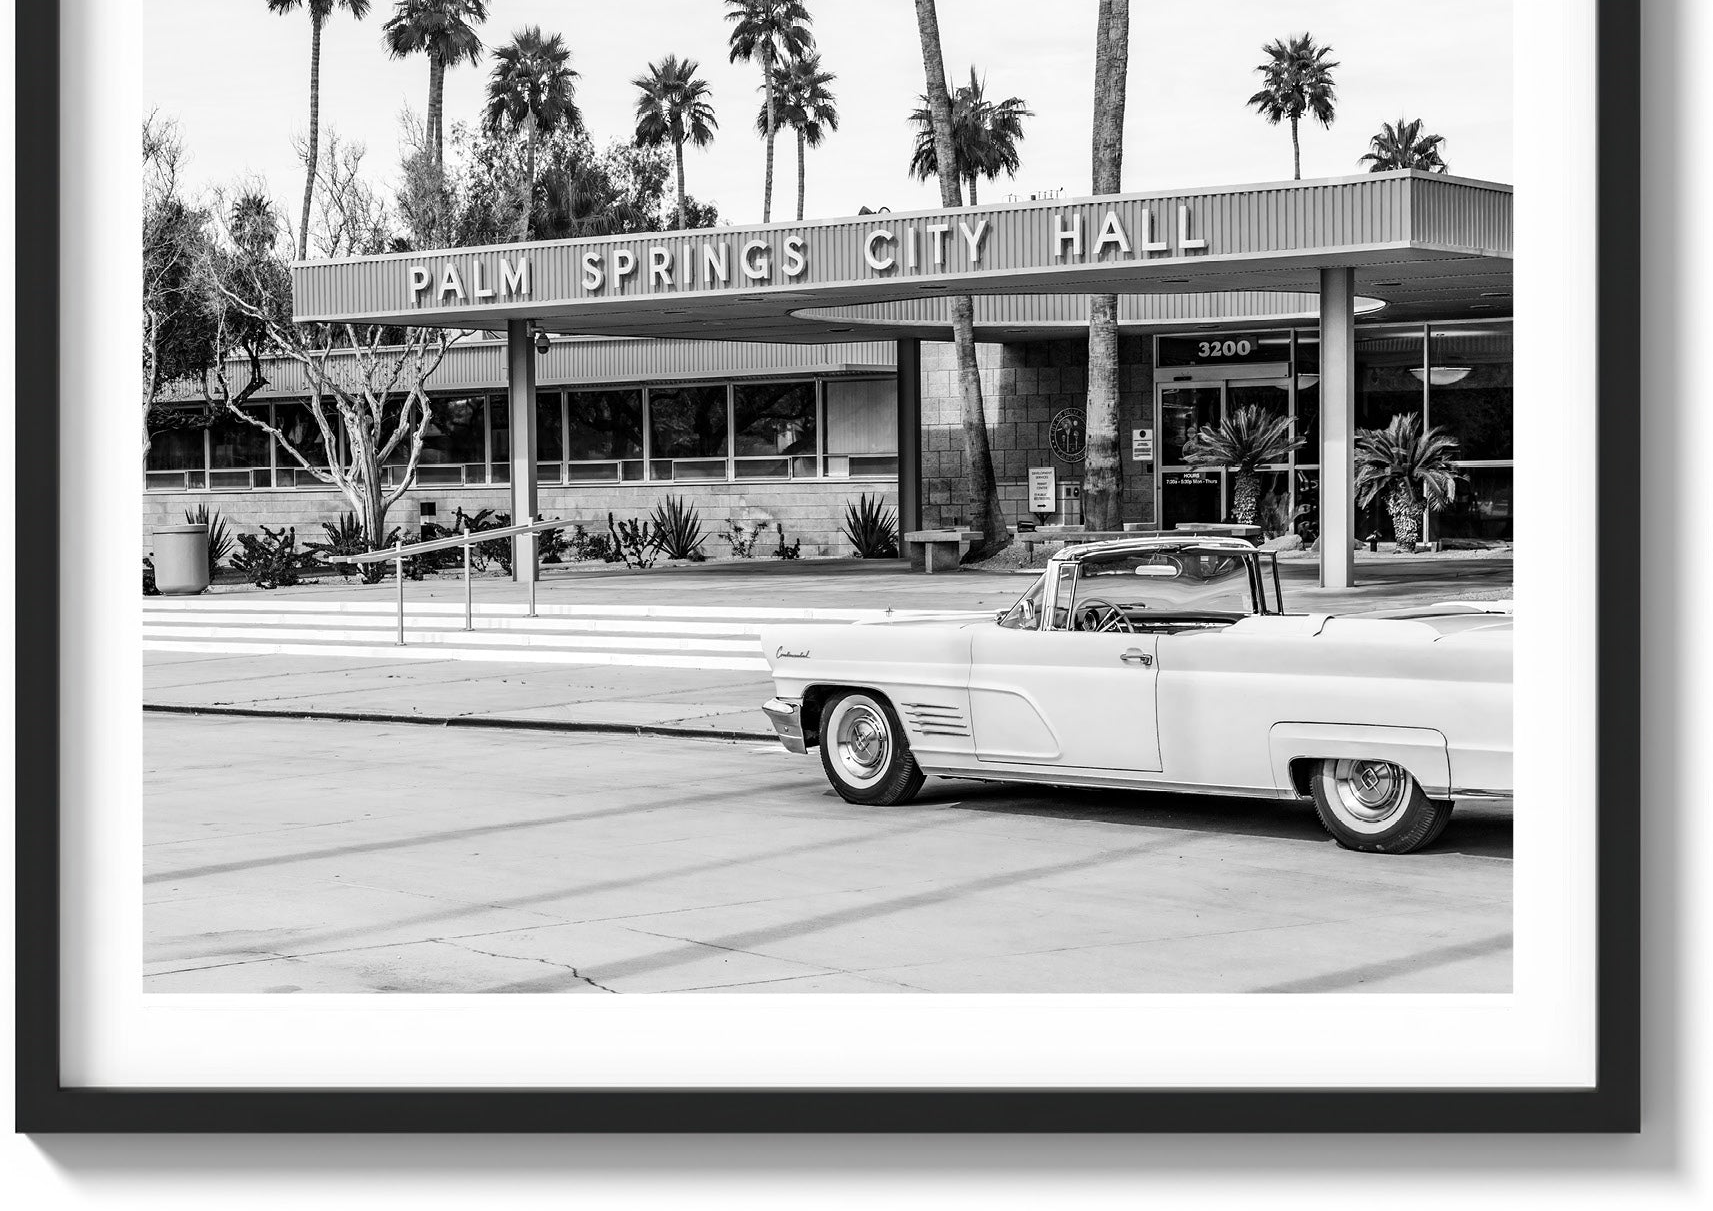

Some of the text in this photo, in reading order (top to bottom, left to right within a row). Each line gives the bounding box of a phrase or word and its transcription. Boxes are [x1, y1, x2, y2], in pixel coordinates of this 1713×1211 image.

[410, 205, 1207, 303] PALM SPRINGS CITY HALL
[1199, 340, 1251, 357] 3200
